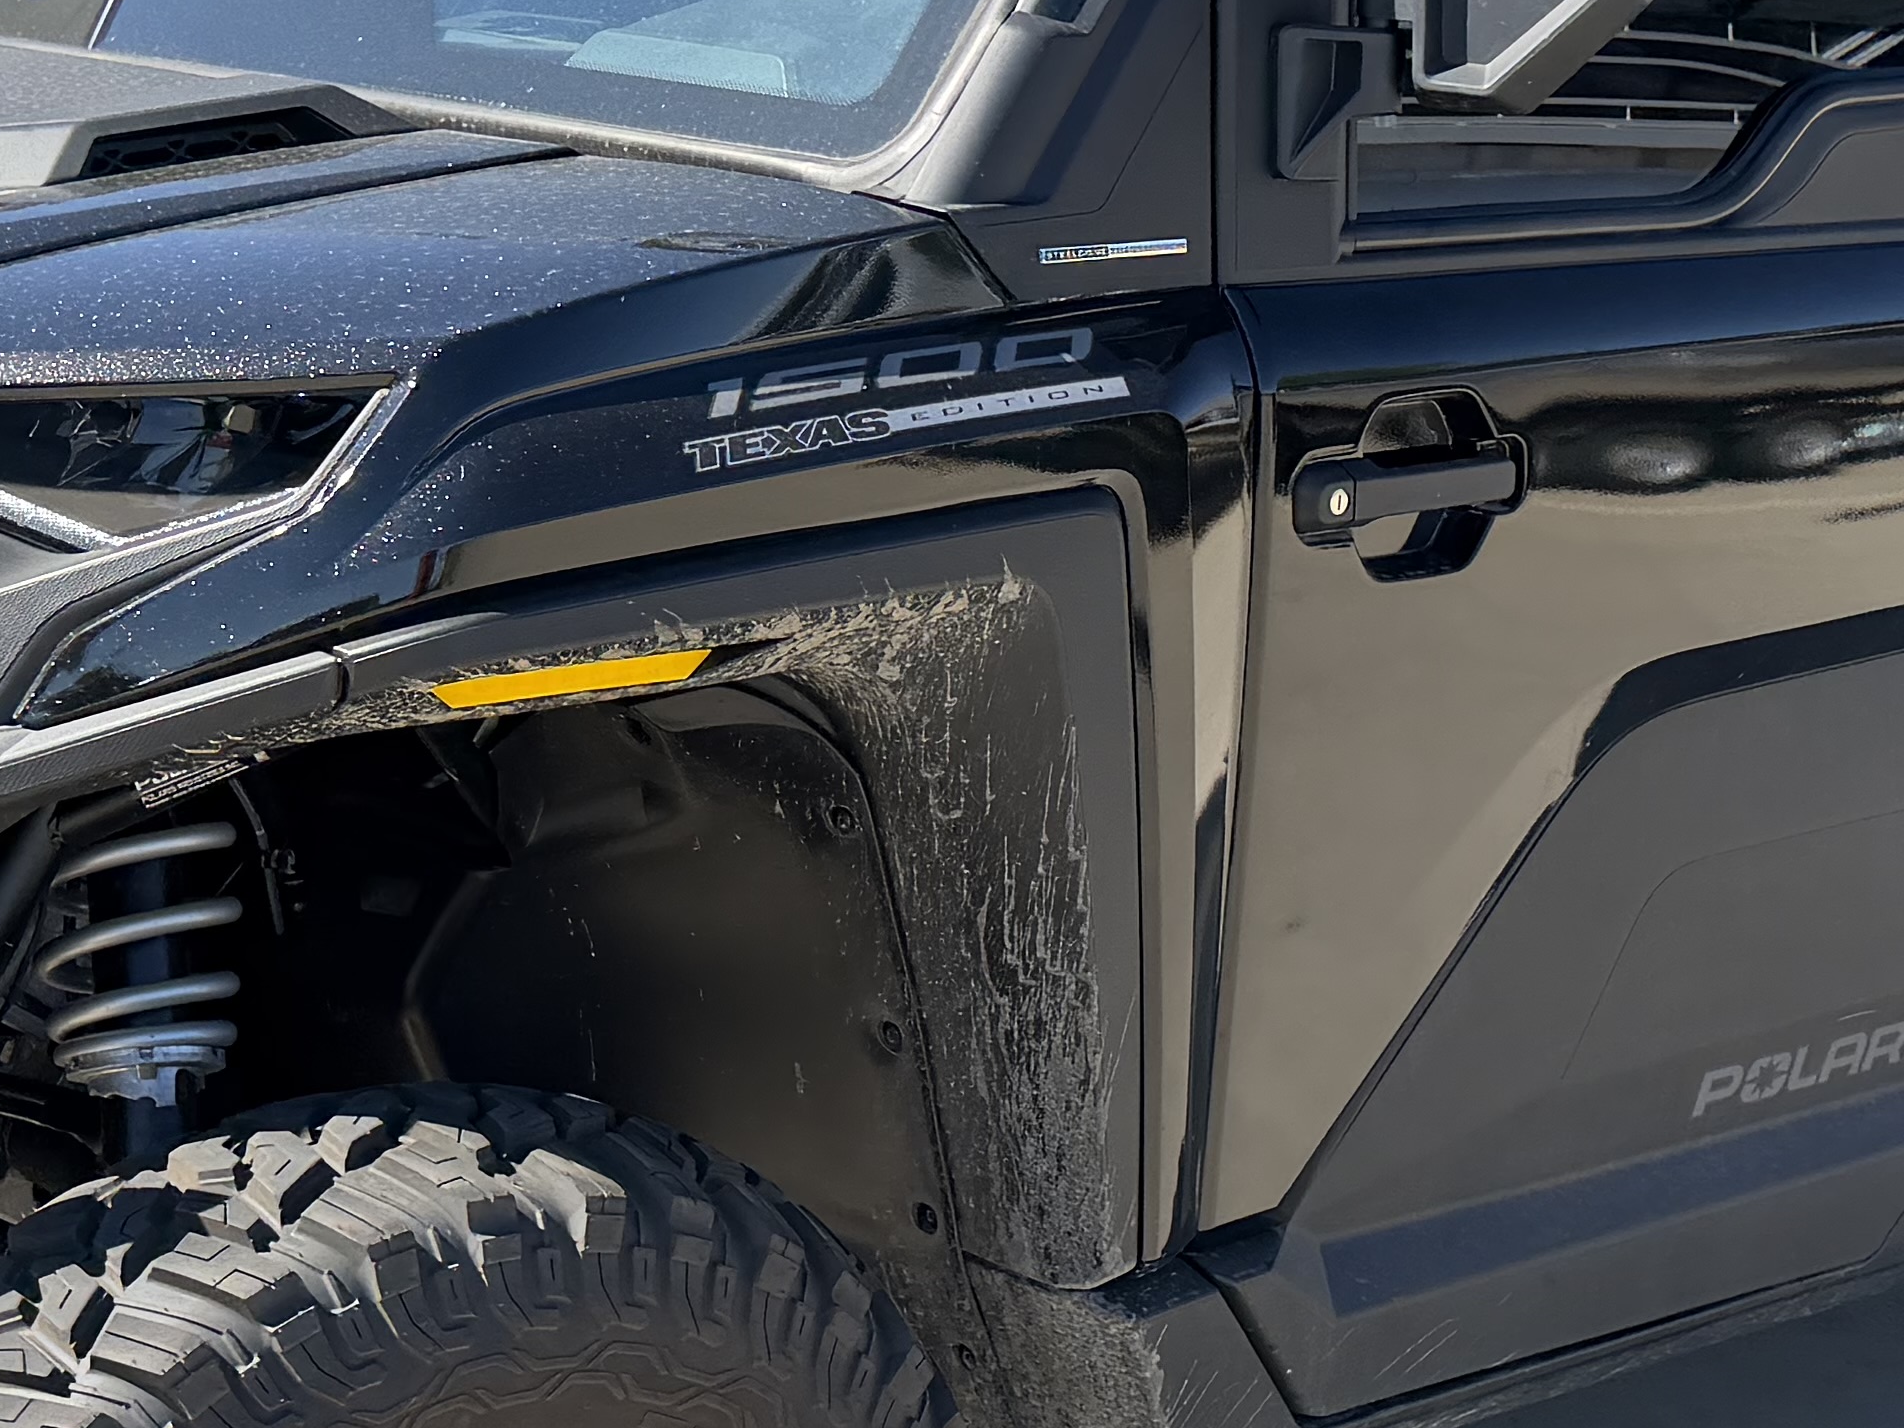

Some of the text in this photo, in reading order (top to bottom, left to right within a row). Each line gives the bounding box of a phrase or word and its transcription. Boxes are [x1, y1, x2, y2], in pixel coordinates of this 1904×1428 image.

[707, 327, 1093, 420] 1500
[682, 384, 1106, 472] TEXAS EDITION
